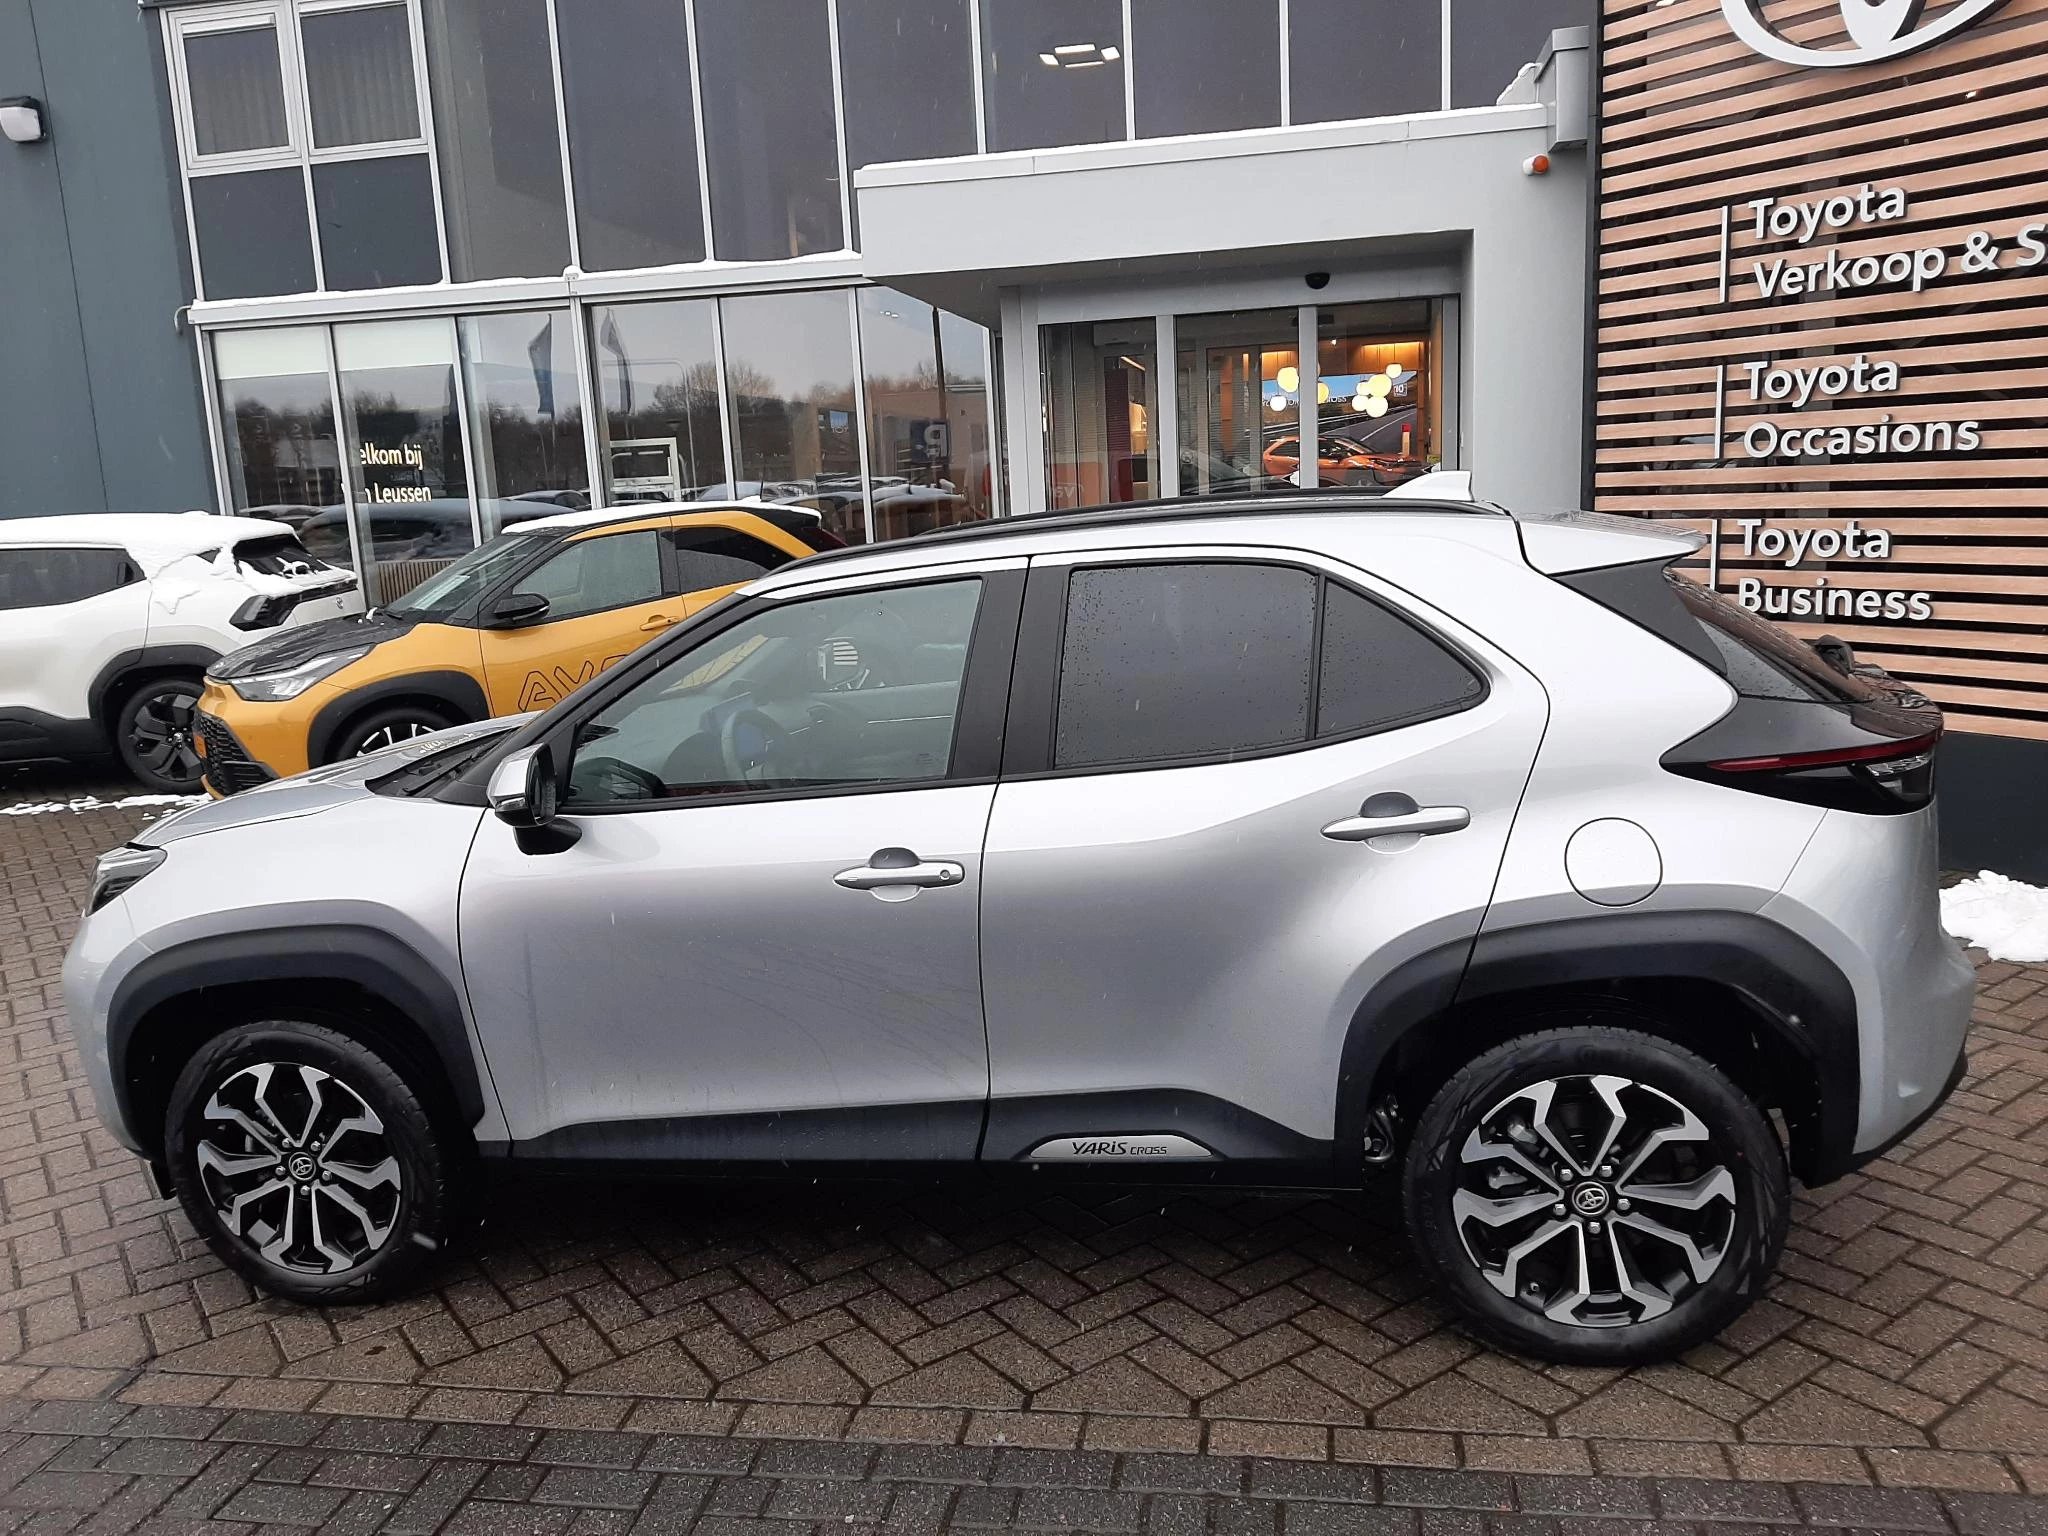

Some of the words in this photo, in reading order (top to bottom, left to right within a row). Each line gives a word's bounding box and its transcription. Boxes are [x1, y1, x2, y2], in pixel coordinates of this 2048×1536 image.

[1749, 183, 1907, 242] Toyota
[1753, 246, 1946, 298] Verkoop
[1960, 231, 2001, 273] &
[1743, 354, 1899, 408] Toyota
[360, 442, 403, 465] elkom
[404, 443, 424, 471] bij
[1743, 414, 1982, 458] Occasions
[374, 482, 432, 503] Leussen
[1736, 519, 1892, 567] Toyota
[1737, 577, 1933, 621] Business
[1130, 1146, 1167, 1155] CROSS
